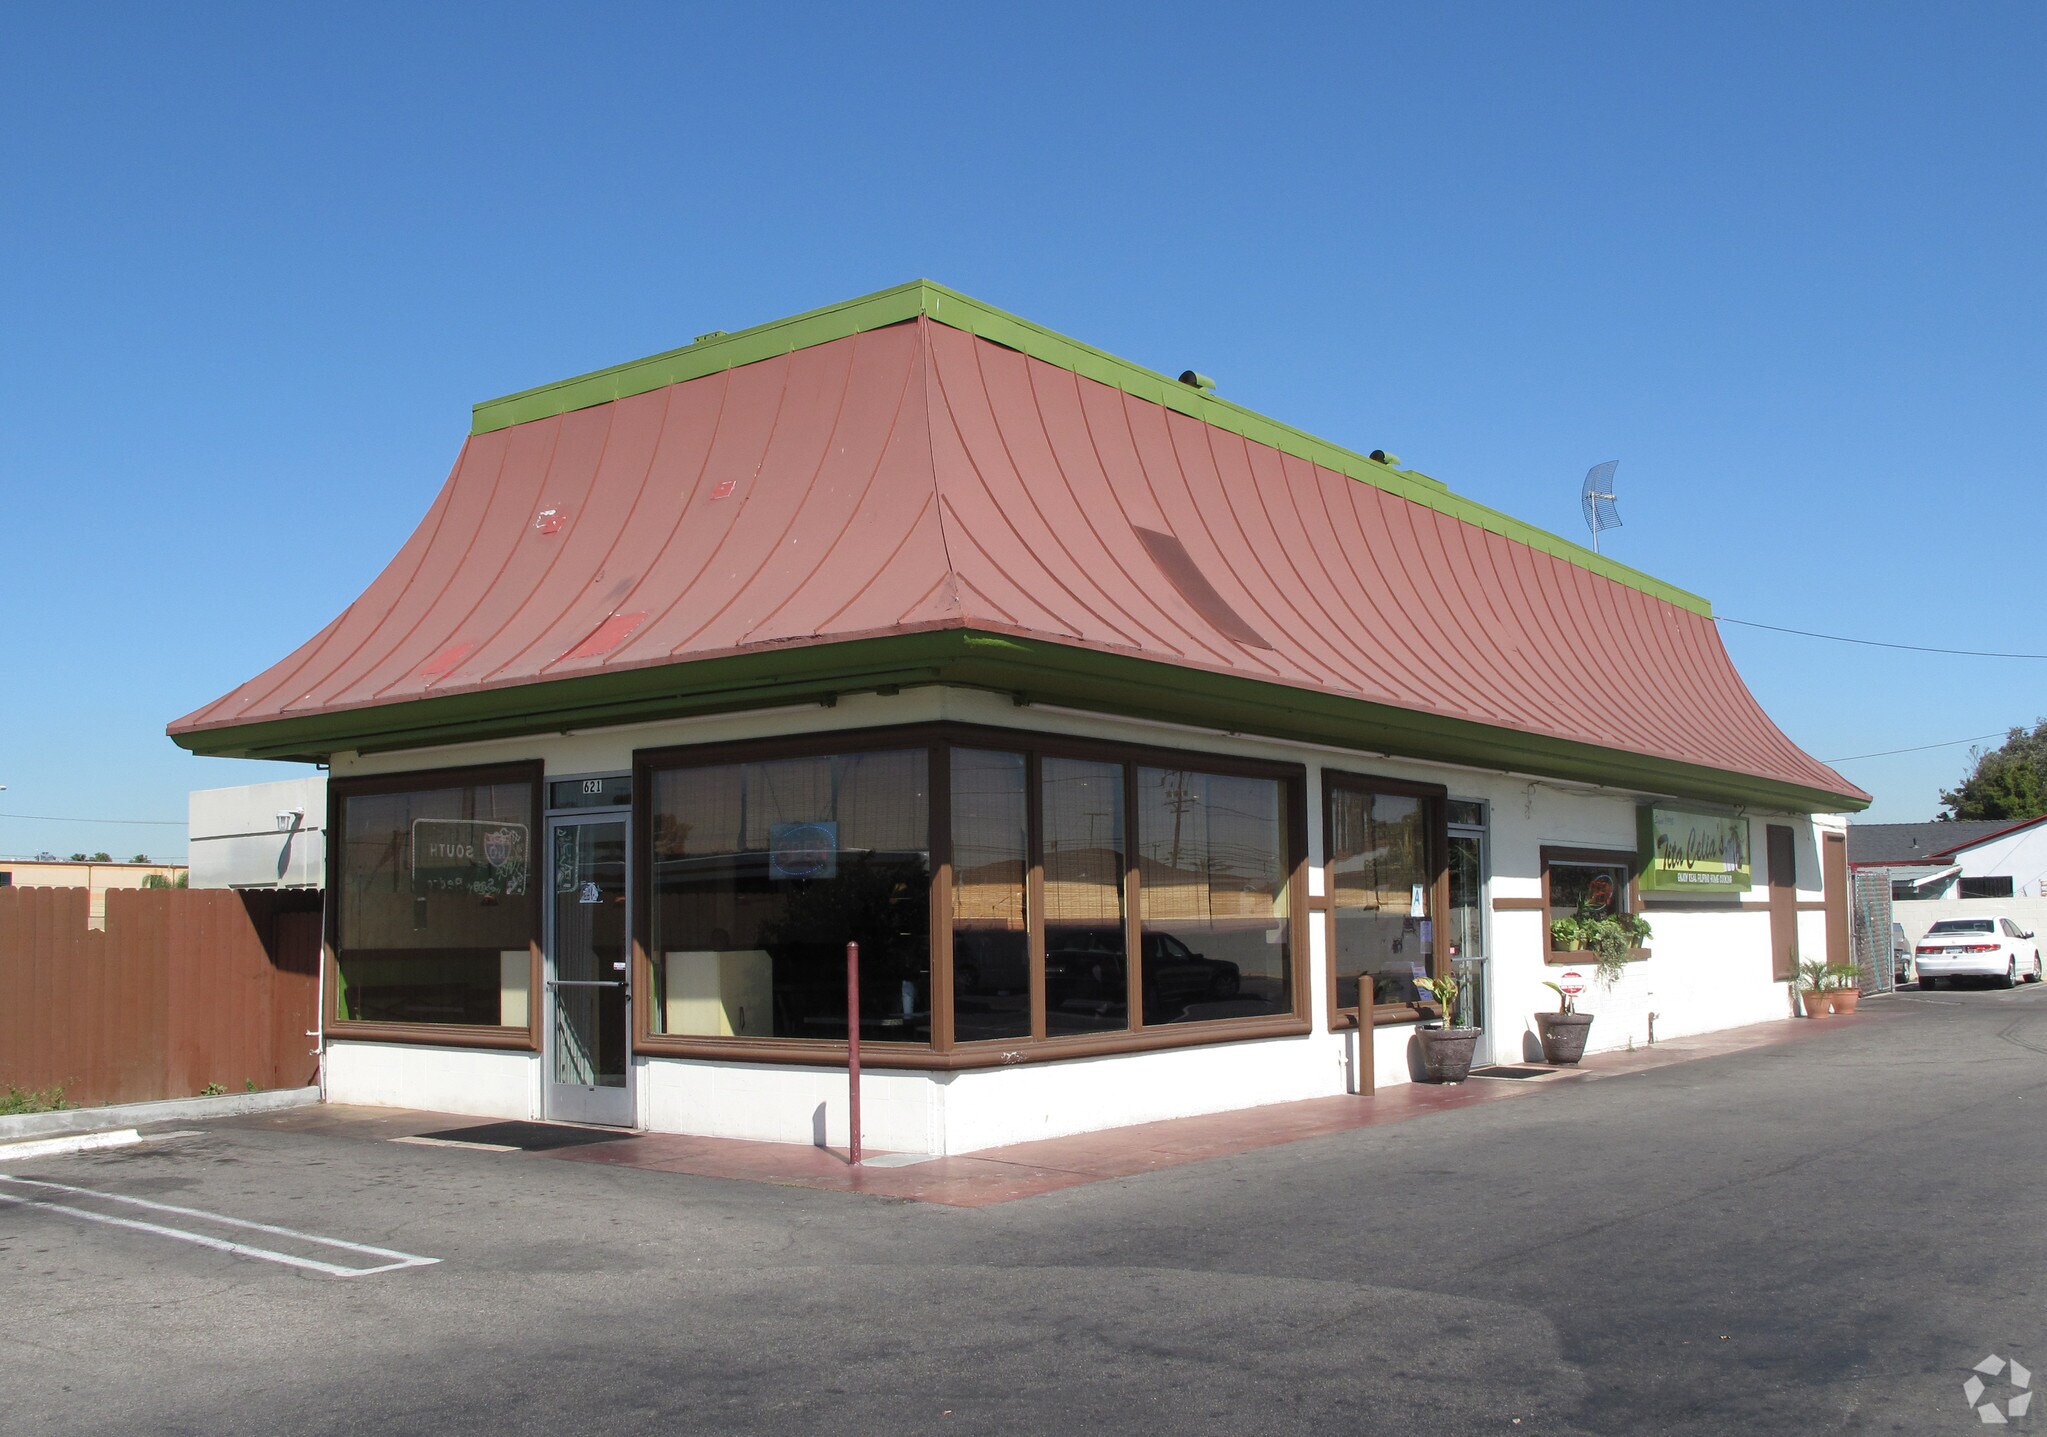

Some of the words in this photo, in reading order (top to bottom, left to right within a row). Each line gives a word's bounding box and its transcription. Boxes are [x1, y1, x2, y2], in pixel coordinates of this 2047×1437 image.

[584, 780, 600, 793] 621
[1657, 834, 1684, 870] Tita
[1686, 823, 1724, 869] Celia's
[1413, 889, 1421, 906] A
